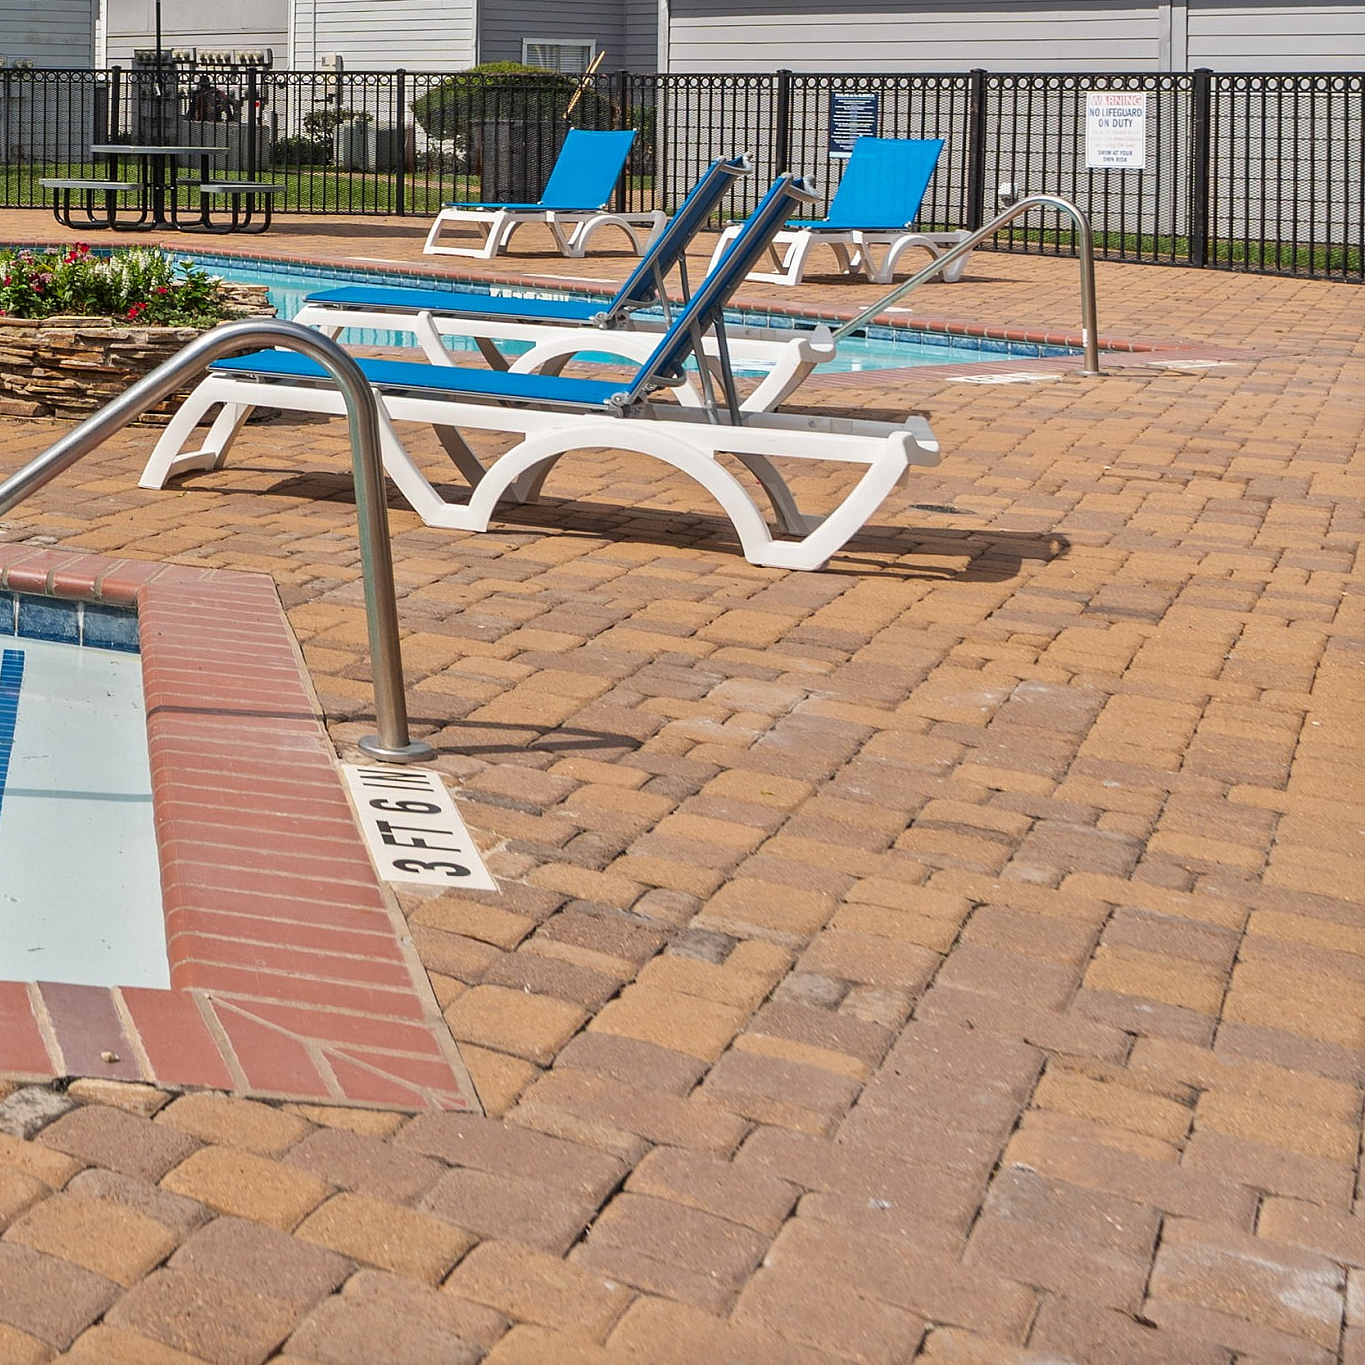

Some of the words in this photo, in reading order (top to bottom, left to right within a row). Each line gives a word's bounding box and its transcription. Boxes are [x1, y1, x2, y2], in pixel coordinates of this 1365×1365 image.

[1091, 96, 1141, 105] WARNING
[1089, 108, 1100, 117] NO
[1102, 108, 1142, 117] LIFEGUARD
[1098, 119, 1109, 127] ON
[1112, 119, 1133, 127] DUTY
[357, 768, 434, 792] IN
[369, 798, 442, 814] 6
[375, 820, 462, 852] FT
[392, 858, 471, 877] 3
